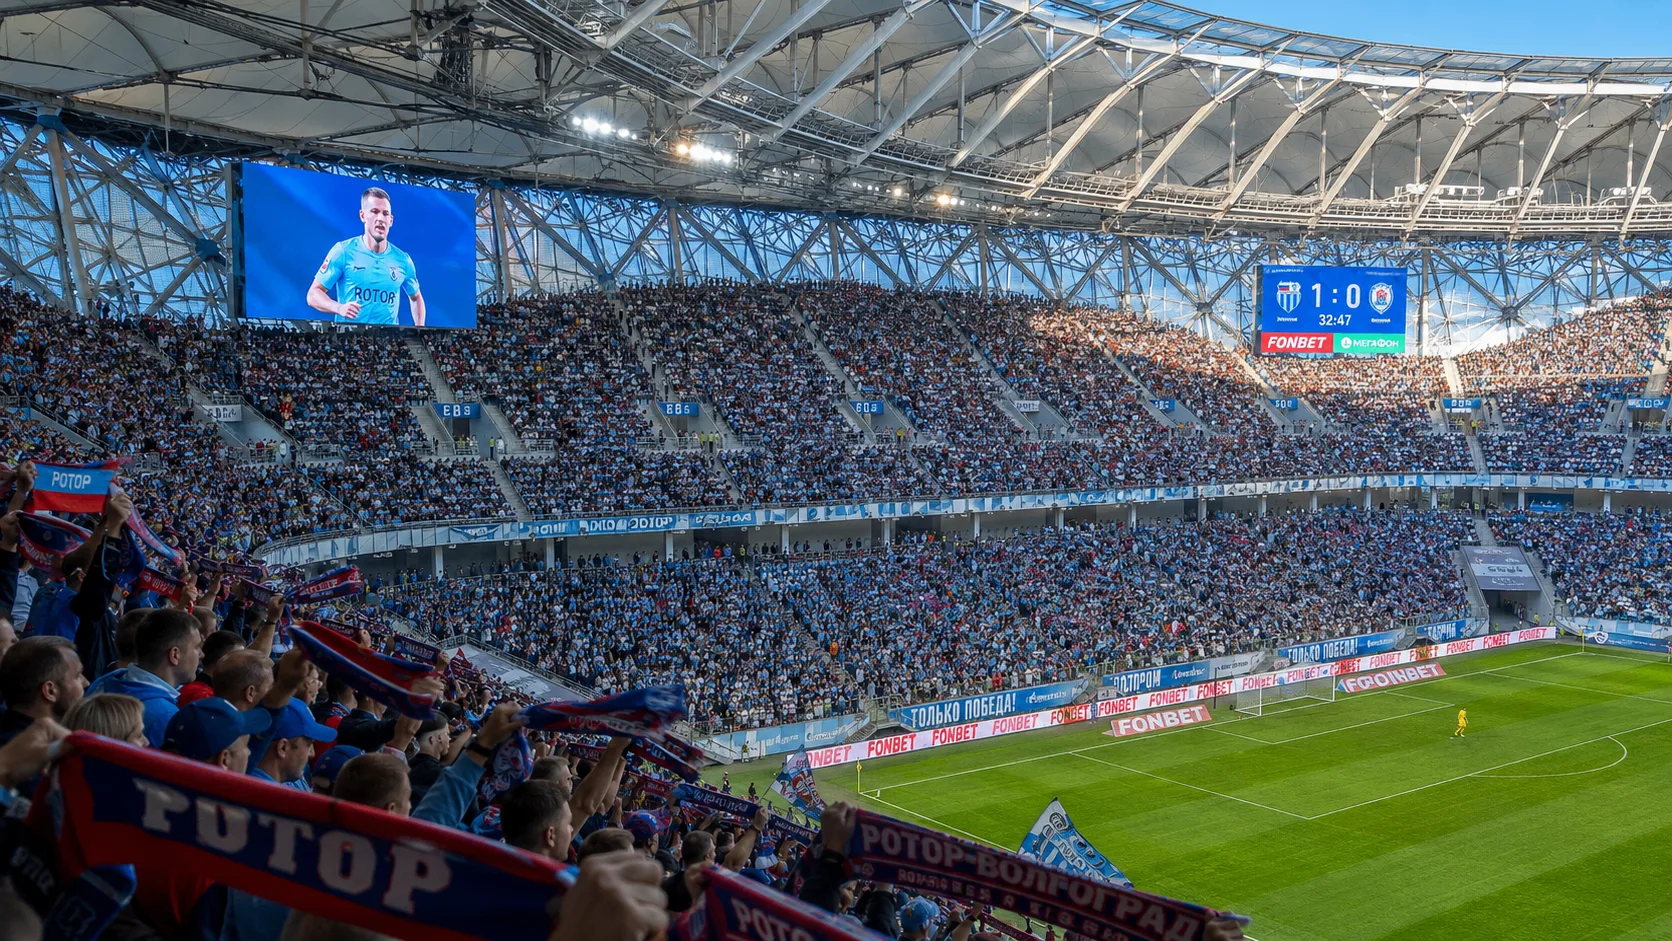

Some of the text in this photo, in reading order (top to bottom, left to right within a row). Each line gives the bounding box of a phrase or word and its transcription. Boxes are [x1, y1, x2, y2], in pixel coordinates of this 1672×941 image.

[354, 287, 396, 304] ROTOR
[1311, 283, 1322, 308] 1
[1346, 283, 1361, 309] 0
[1318, 314, 1352, 326] 32:47
[1267, 336, 1327, 349] FONBET
[1353, 339, 1399, 348] МЕГАФОН
[51, 471, 92, 490] РОТОР
[910, 701, 960, 729] ТОЛЬКО
[965, 692, 1017, 720] ПОБЕДА!
[1118, 705, 1204, 735] FONBET
[867, 733, 917, 758] FONBET
[931, 723, 979, 746] FONBET
[992, 713, 1039, 735] FONBET
[1098, 696, 1139, 716] FONBET
[1148, 688, 1188, 707] FONBET
[859, 822, 1201, 941] РОТОР-ВОЛГОГРАД
